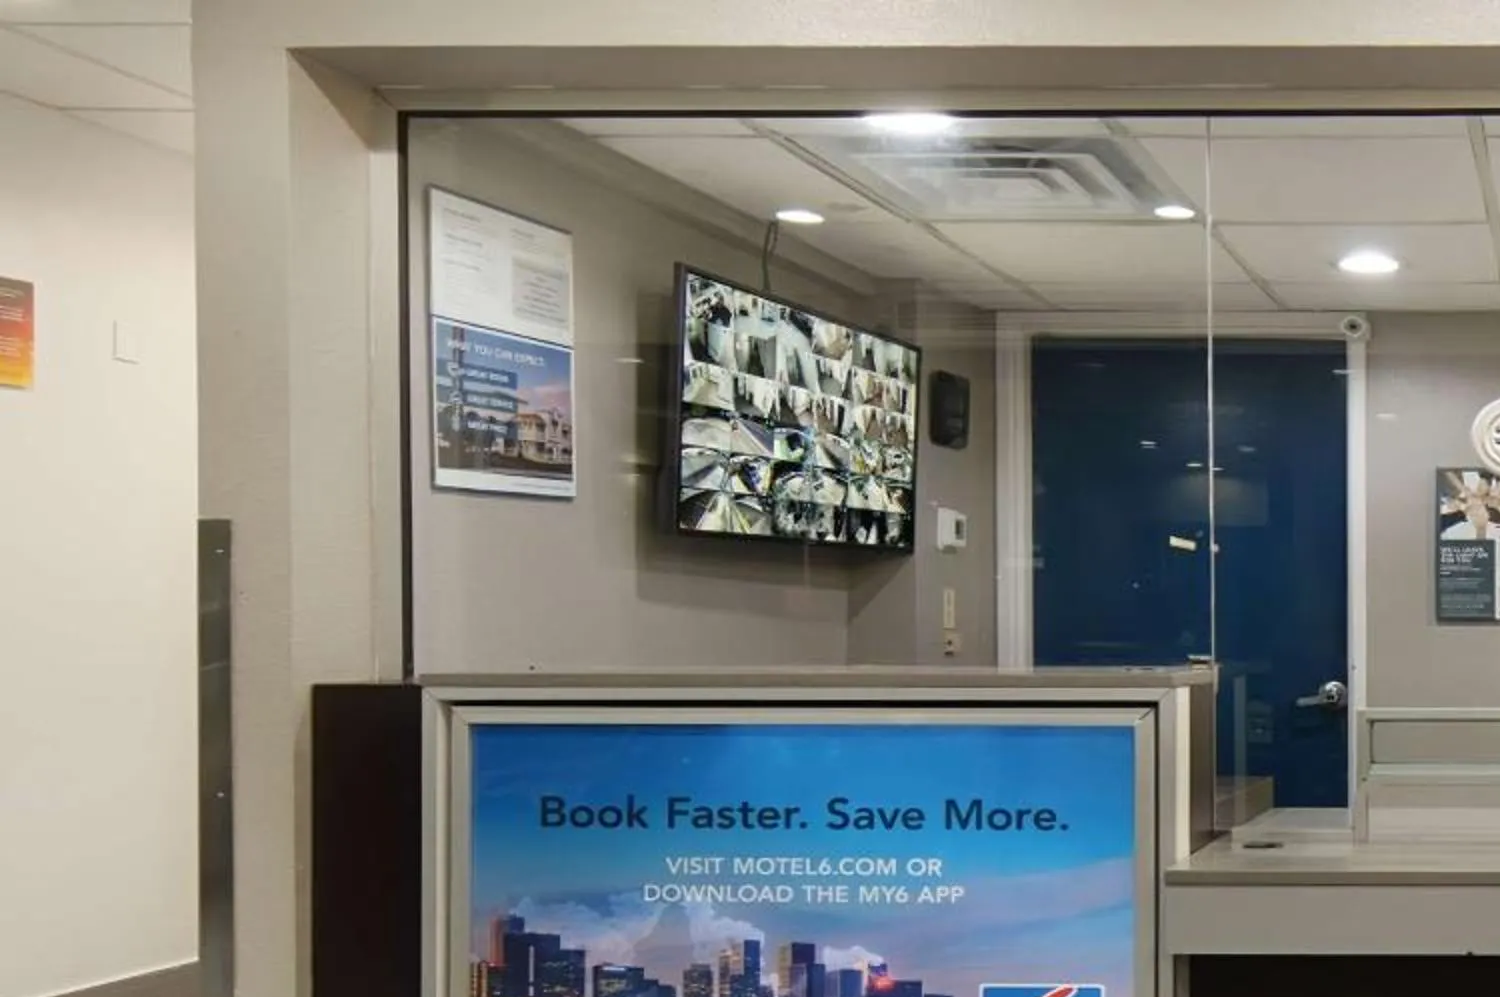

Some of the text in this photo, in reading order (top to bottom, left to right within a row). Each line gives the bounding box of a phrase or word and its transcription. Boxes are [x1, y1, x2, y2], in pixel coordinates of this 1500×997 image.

[540, 795, 1069, 832] Book Faster. Save More.
[665, 856, 943, 877] VISIT MOTEL6.COM OR
[643, 884, 965, 905] DOWNLOAD THE MY6 APP
